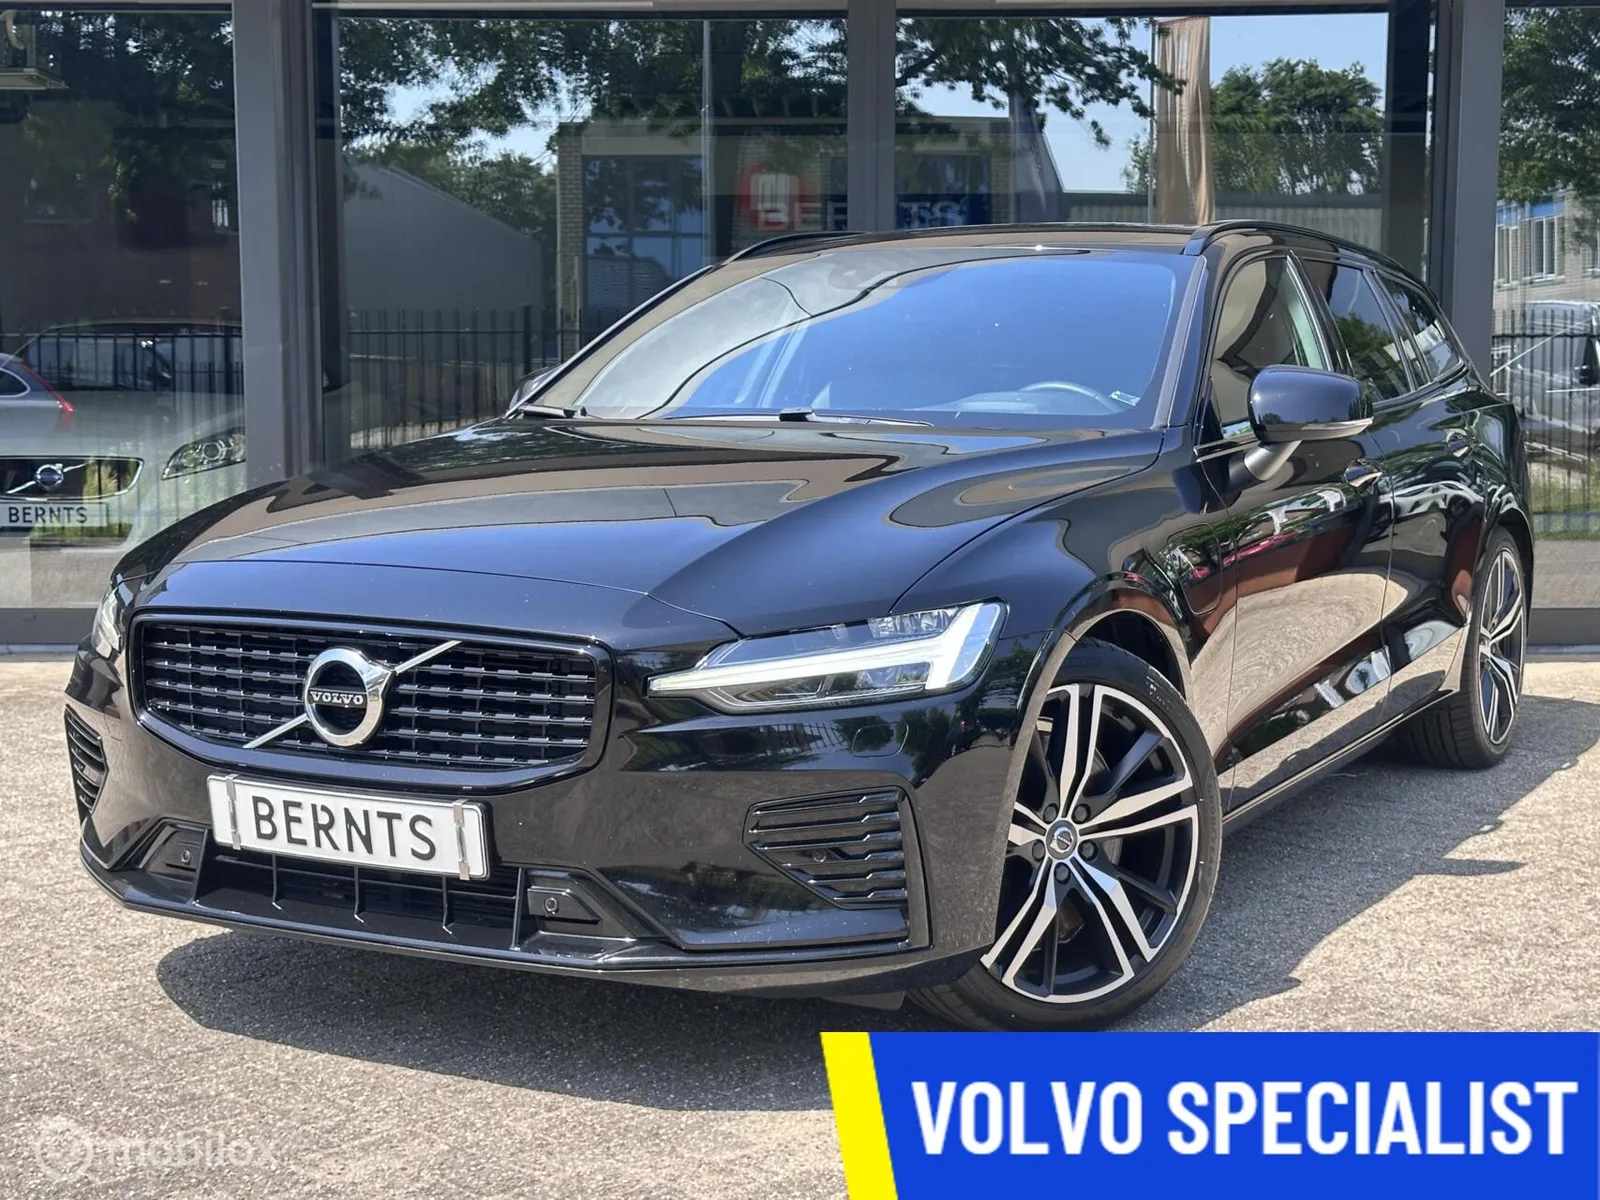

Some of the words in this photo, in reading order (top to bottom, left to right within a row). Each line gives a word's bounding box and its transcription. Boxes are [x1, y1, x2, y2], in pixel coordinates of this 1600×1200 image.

[8, 506, 88, 524] BERNTS
[309, 691, 364, 705] VOLVO
[251, 795, 436, 861] BERNTS
